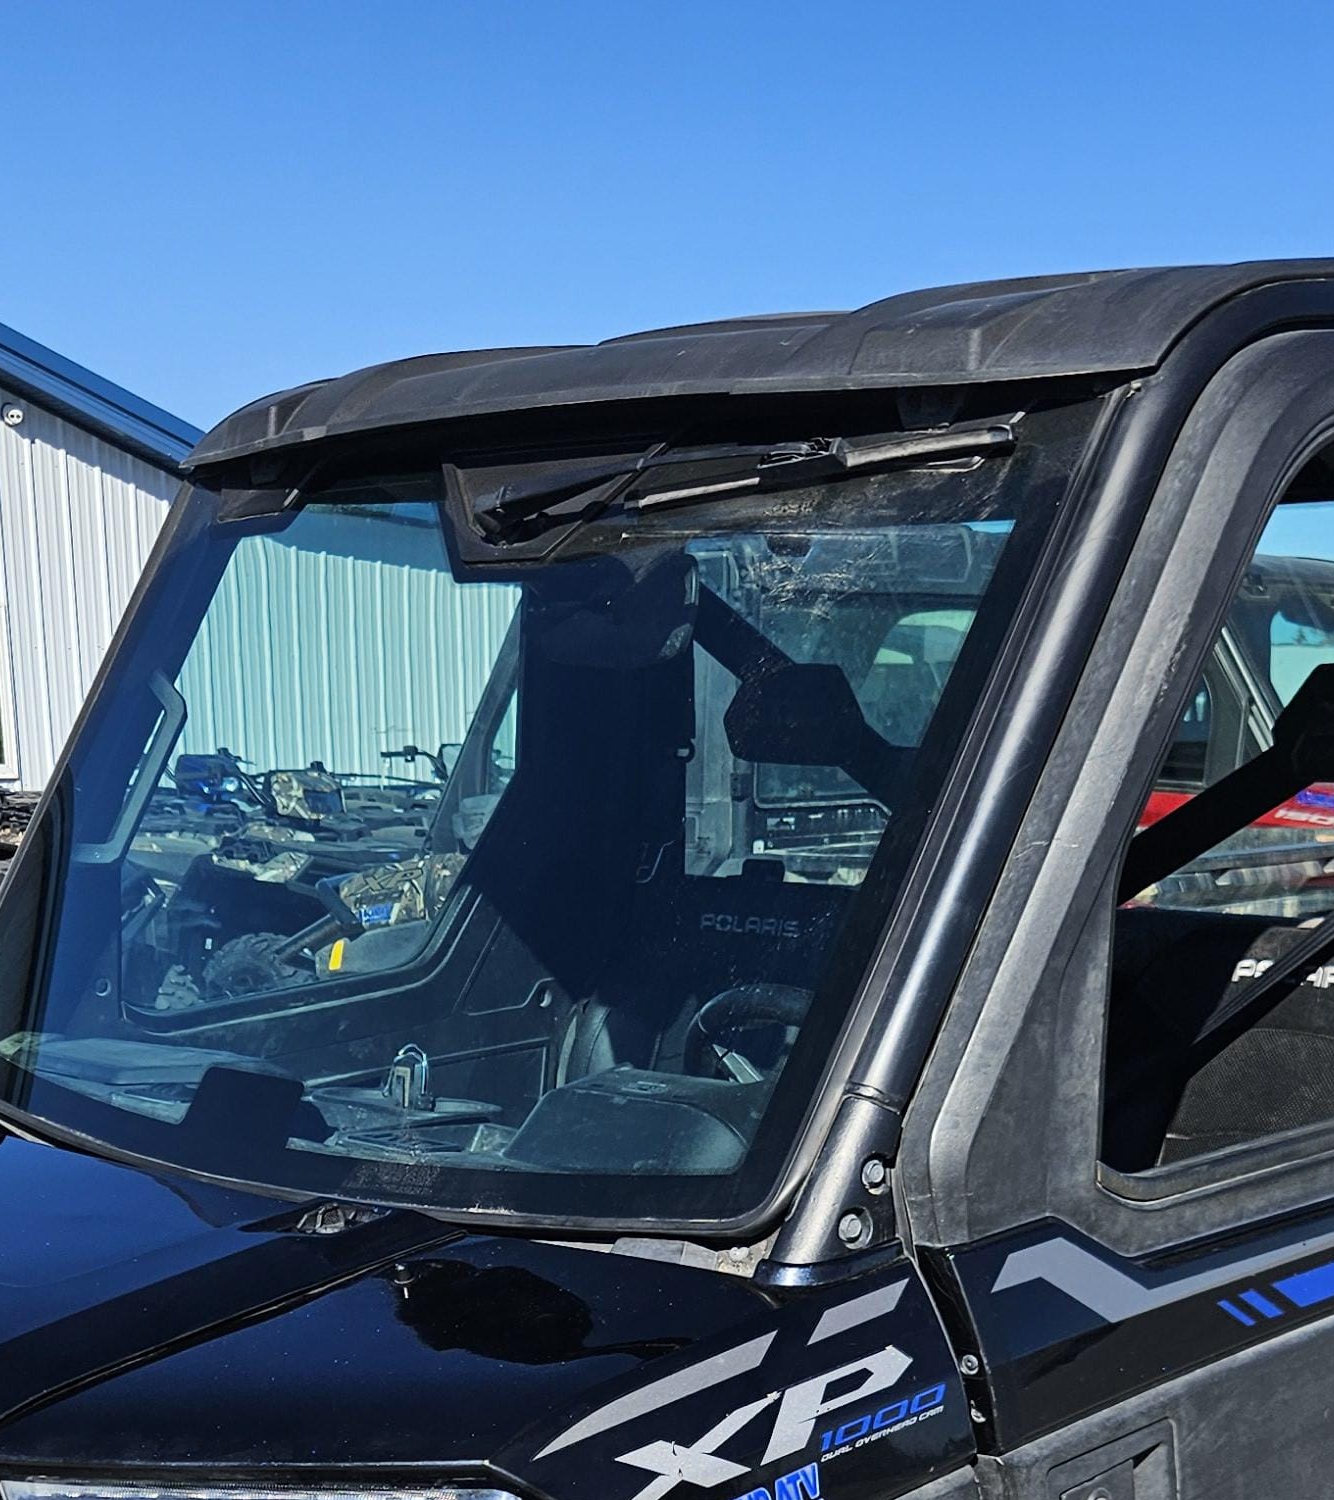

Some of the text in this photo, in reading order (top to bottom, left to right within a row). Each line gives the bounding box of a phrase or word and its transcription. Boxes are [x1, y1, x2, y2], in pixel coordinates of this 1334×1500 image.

[700, 913, 801, 938] POLARIS
[820, 1382, 947, 1453] 1000
[820, 1443, 854, 1463] DUAL
[854, 1416, 918, 1448] OVERHEAD
